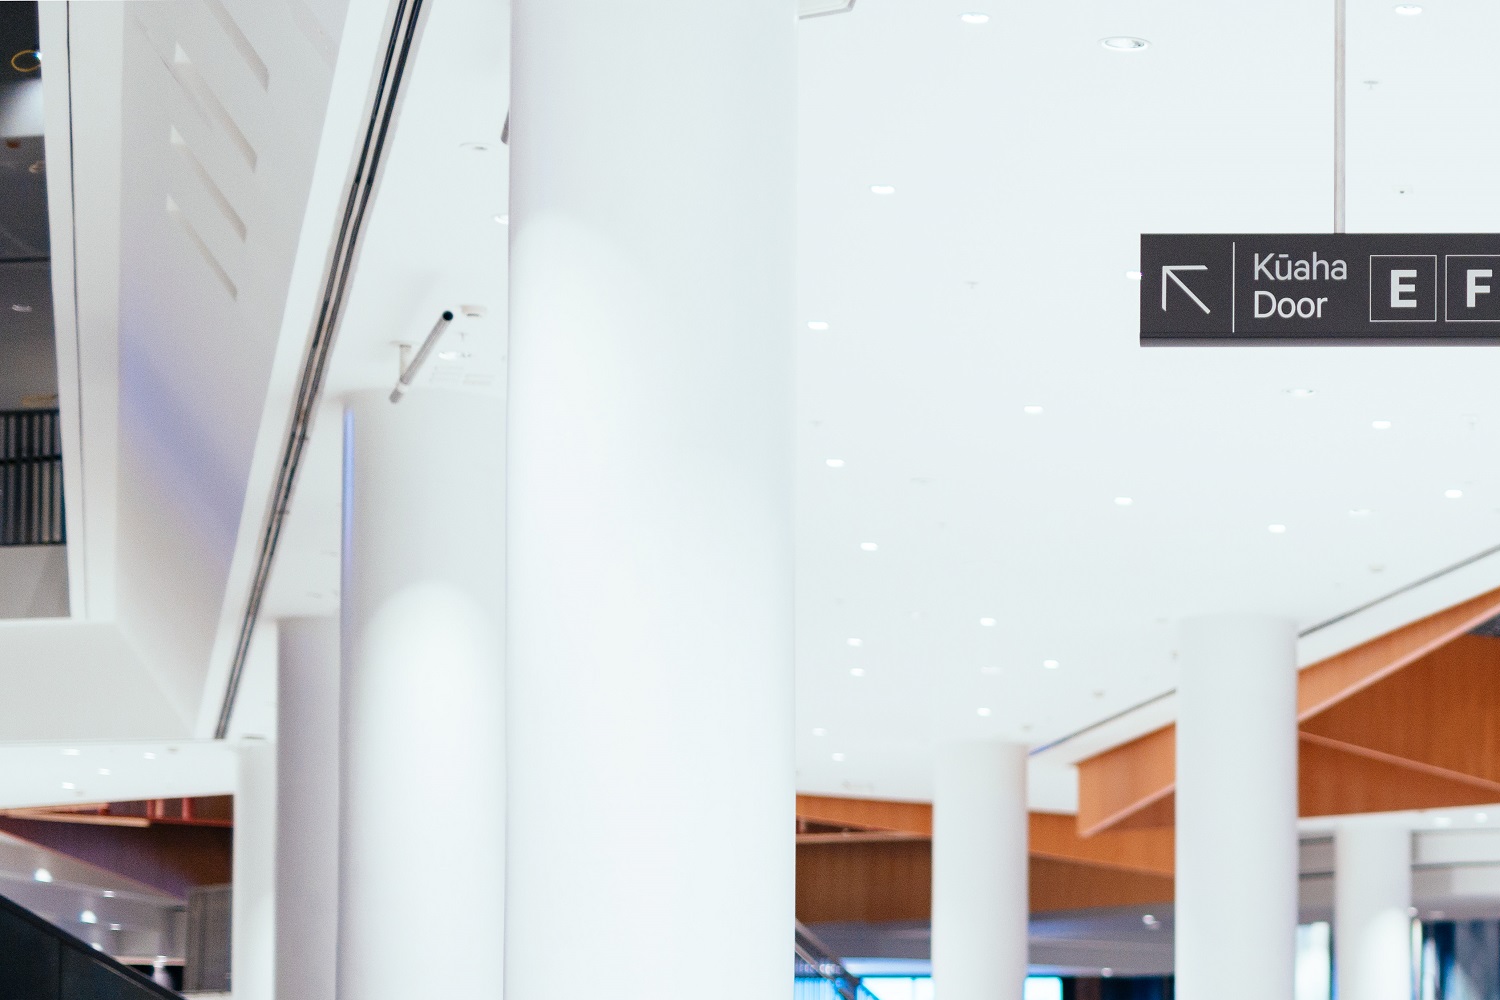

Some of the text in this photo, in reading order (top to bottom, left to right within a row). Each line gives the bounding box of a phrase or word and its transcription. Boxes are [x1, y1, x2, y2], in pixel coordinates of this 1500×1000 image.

[1254, 252, 1348, 281] Kūaha
[1390, 269, 1493, 308] E F
[1253, 290, 1329, 319] Door
